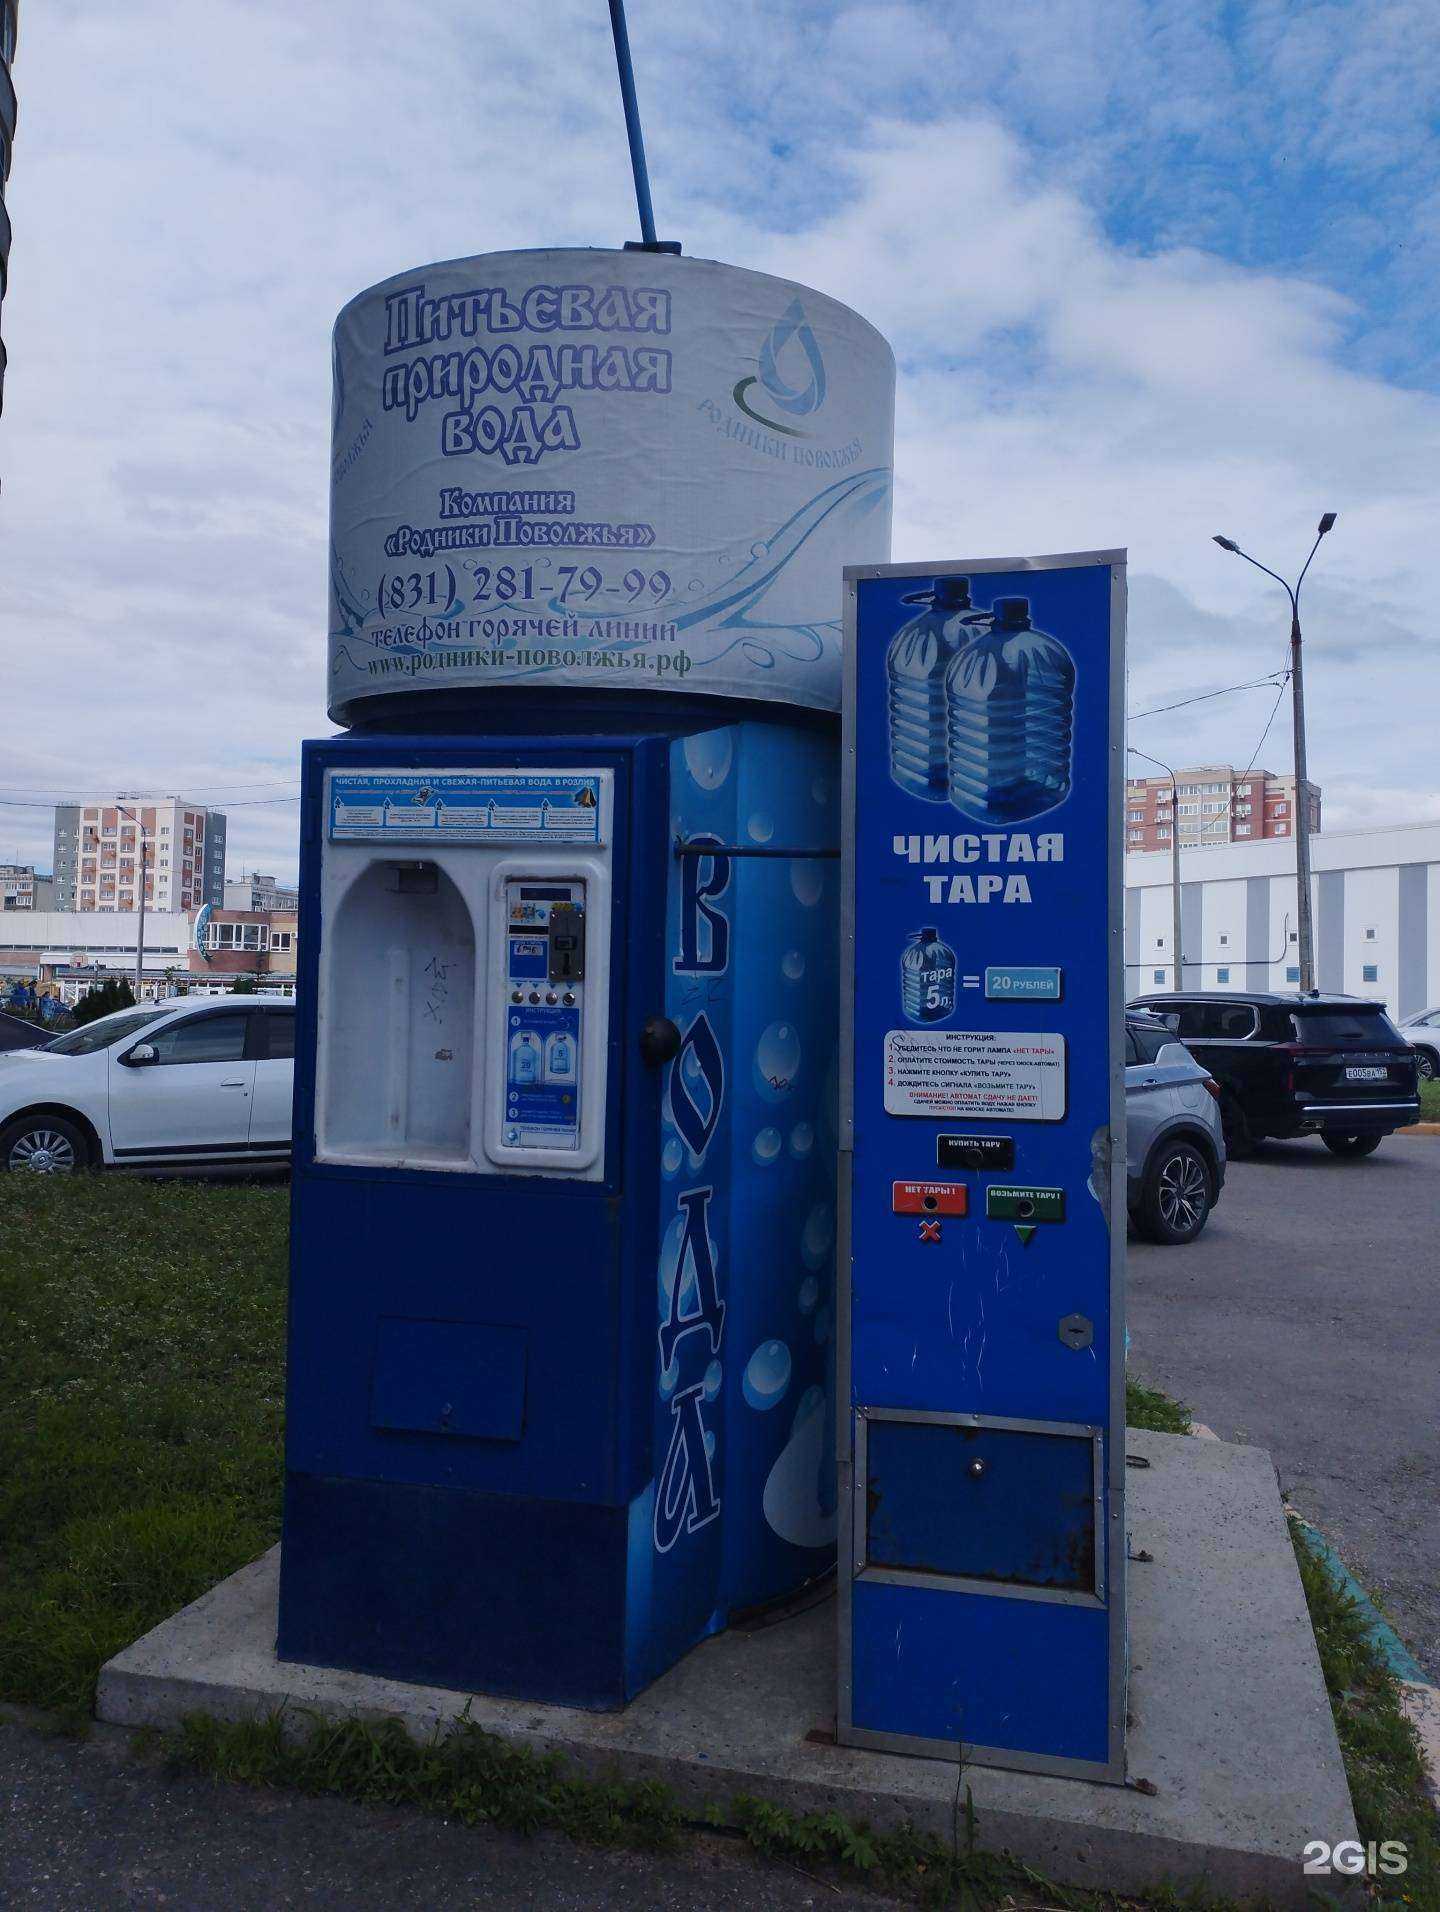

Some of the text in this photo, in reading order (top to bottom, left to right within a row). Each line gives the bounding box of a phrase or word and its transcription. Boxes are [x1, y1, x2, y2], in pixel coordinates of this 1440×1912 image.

[383, 284, 672, 356] Питьевая
[381, 345, 672, 422] природная
[441, 404, 582, 466] вода
[438, 487, 576, 519] Компания
[376, 564, 673, 620] (831) 281-79-99
[370, 614, 678, 648] телефон горячей линии
[528, 777, 552, 786] ВОДА
[892, 833, 1064, 864] ЧИСТАЯ
[923, 874, 1033, 904] ТАРА
[920, 965, 953, 984] тара
[992, 976, 1054, 991] 20 РУБЛЕЙ
[946, 1034, 997, 1042] ИНСТРУКЦИЯ:
[897, 1044, 937, 1052] УБЕДИТЕСЬ
[938, 1045, 952, 1053] ЧТО
[953, 1045, 963, 1053] НЕ
[897, 1055, 933, 1064] ОПЛАТИТЕ
[933, 1057, 975, 1065] СТОИМОСТЬ
[897, 1067, 931, 1076] НАЖМИТЕ
[897, 1079, 940, 1089] ДОЖДИТЕСЬ
[948, 1139, 1001, 1148] КУПИТЬ ТАРУ
[904, 1185, 922, 1193] НЕТ
[923, 1186, 950, 1195] ТАРЫ
[990, 1189, 1035, 1198] ВОЗЬМИТЕ
